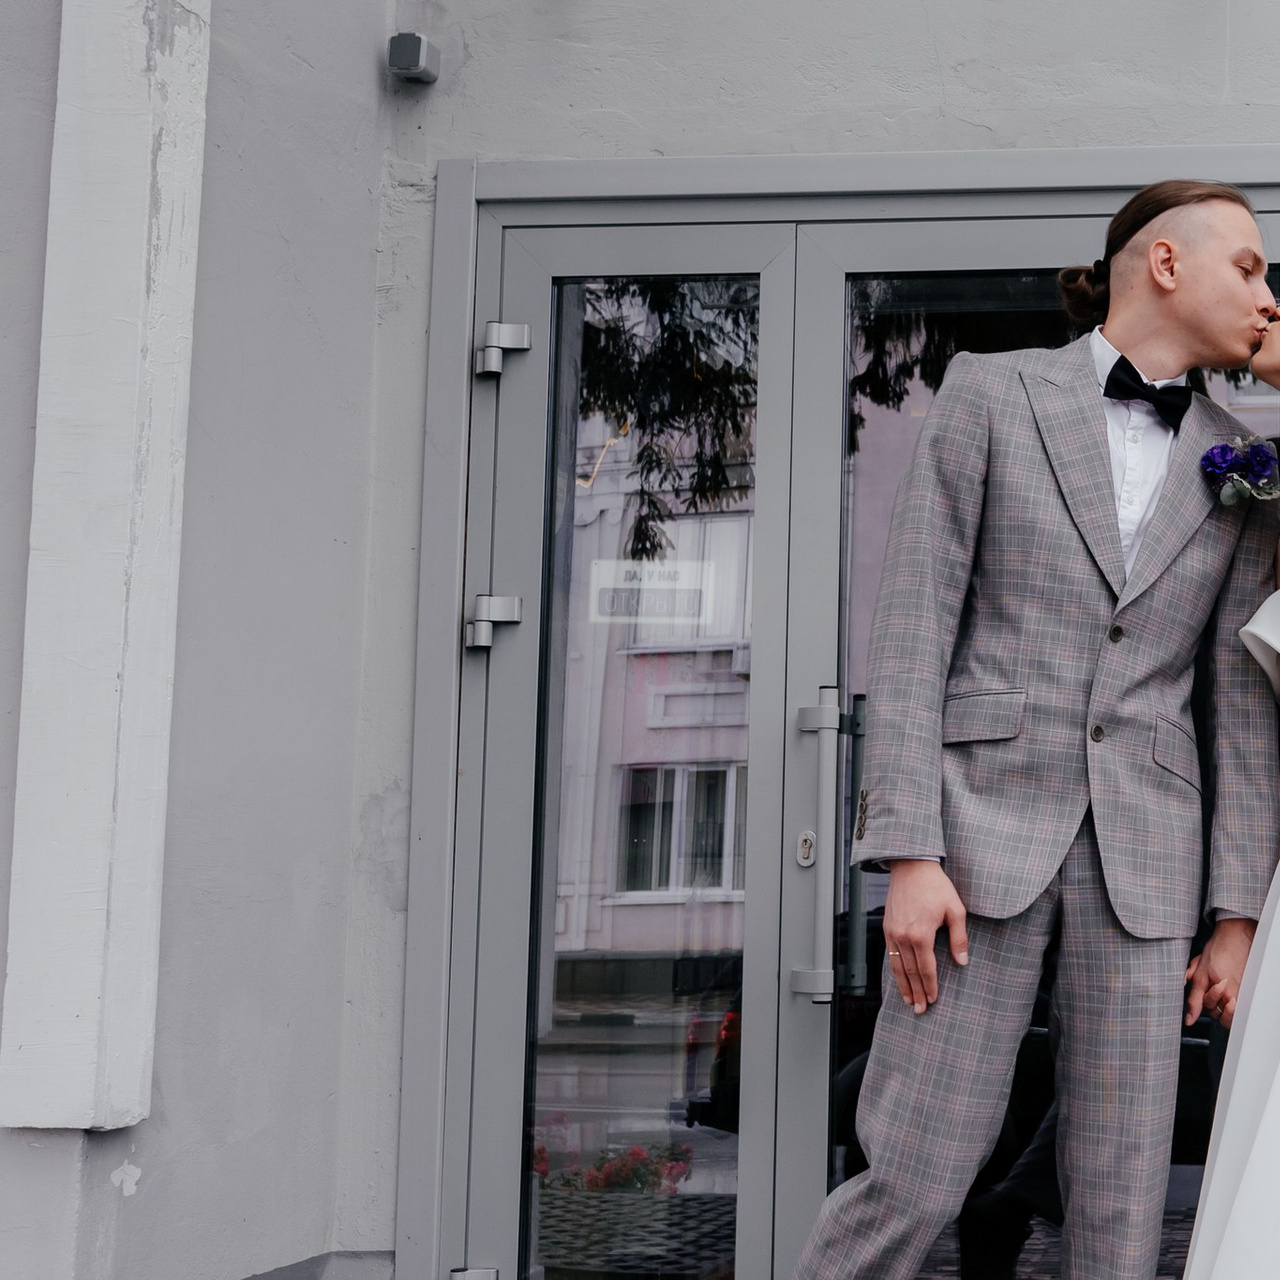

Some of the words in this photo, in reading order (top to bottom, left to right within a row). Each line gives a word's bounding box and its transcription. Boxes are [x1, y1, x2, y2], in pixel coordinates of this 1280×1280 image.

[623, 569, 643, 583] ДА,
[646, 569, 655, 581] У
[658, 569, 680, 582] НАС
[604, 591, 697, 614] ОТКРЫТО
